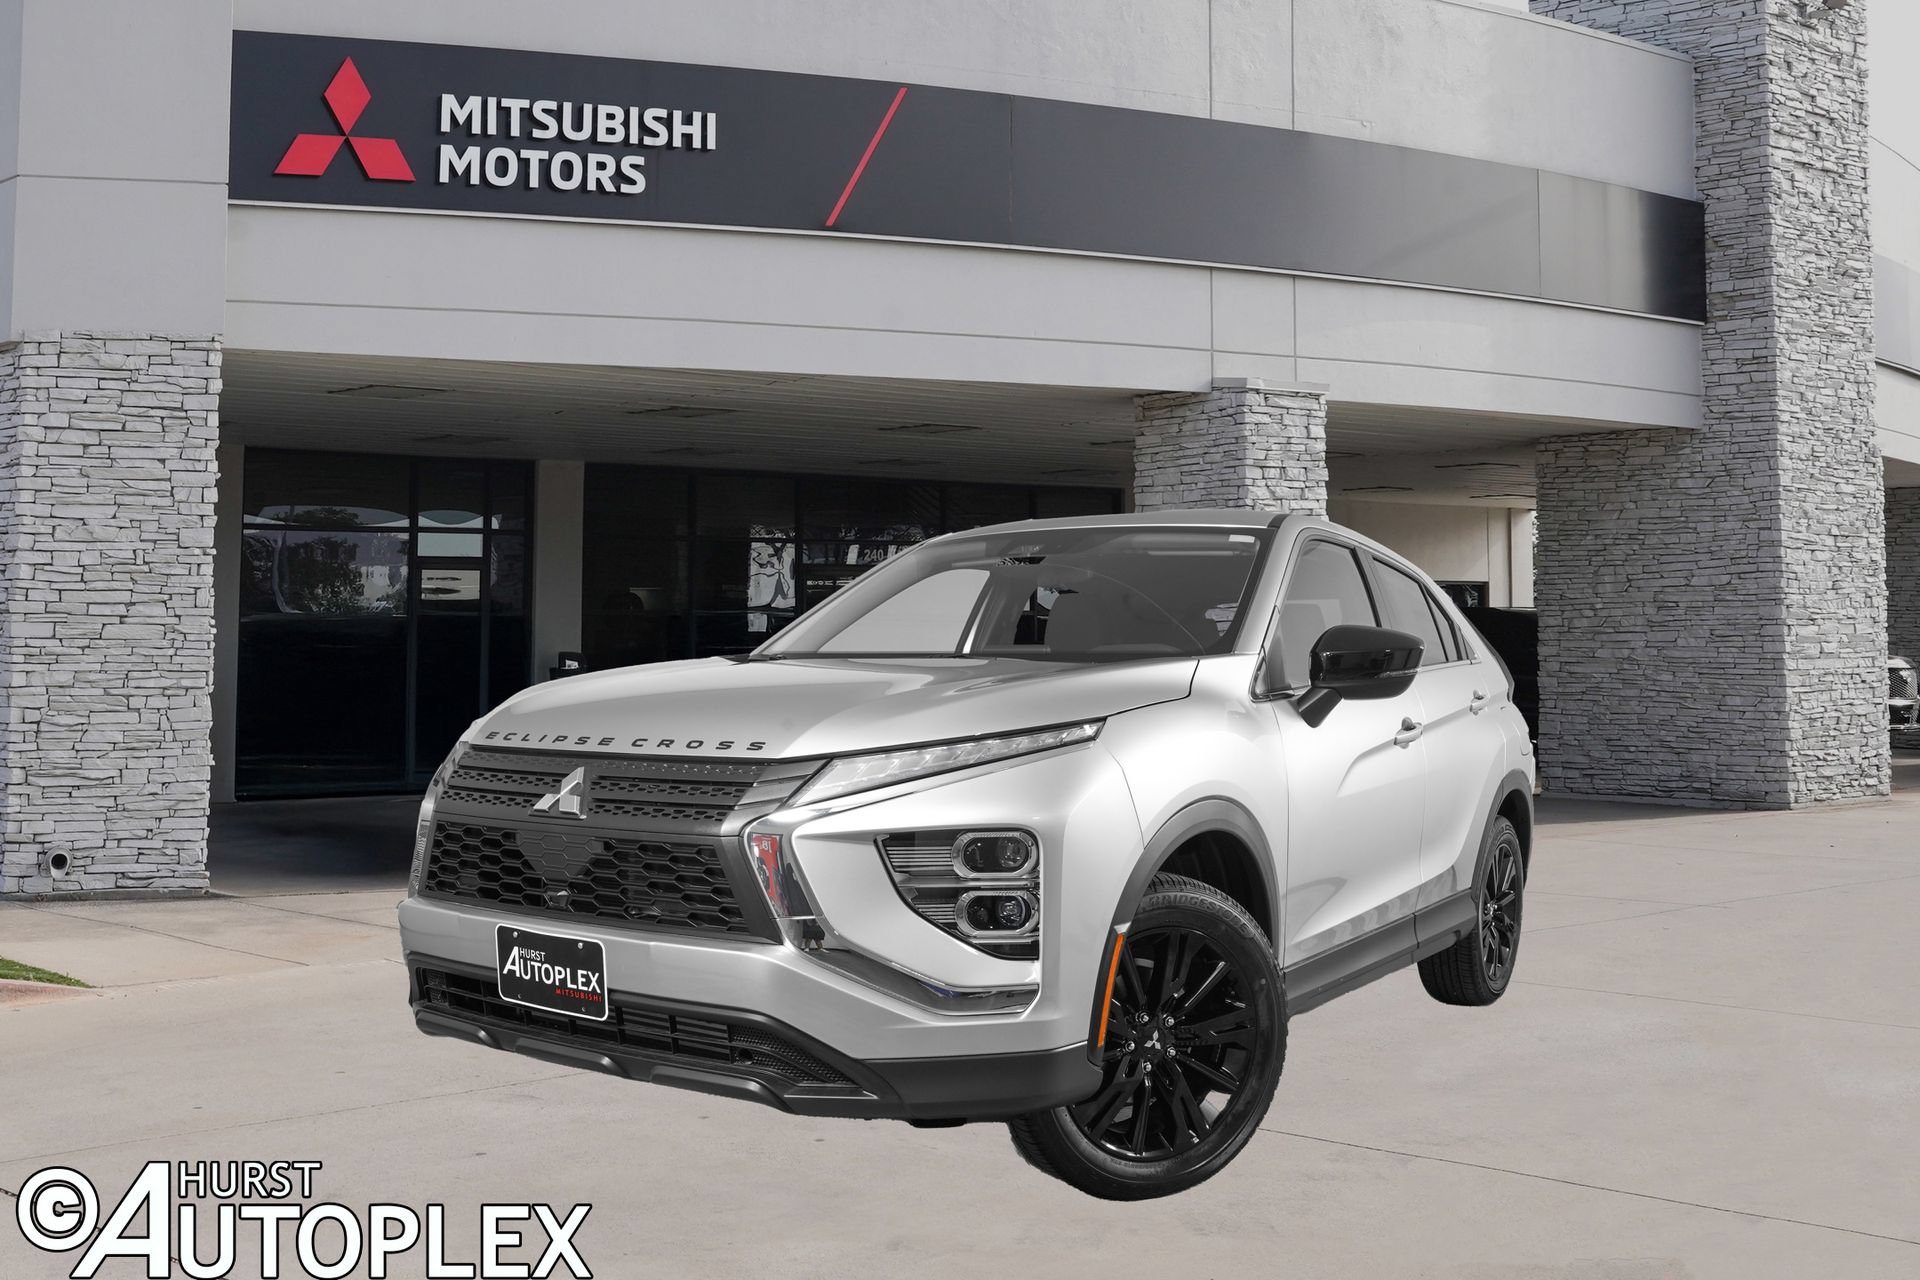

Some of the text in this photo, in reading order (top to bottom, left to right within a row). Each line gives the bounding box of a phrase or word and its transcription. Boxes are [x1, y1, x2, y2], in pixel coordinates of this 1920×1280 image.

[440, 93, 717, 149] MITSUBISHI
[438, 143, 647, 194] MOTORS
[863, 548, 884, 562] 240
[484, 731, 767, 752] ECLIPSE CROSS
[519, 947, 546, 962] HURST
[502, 945, 601, 994] AUTOPLEX
[554, 987, 603, 1003] MITSUBISHI
